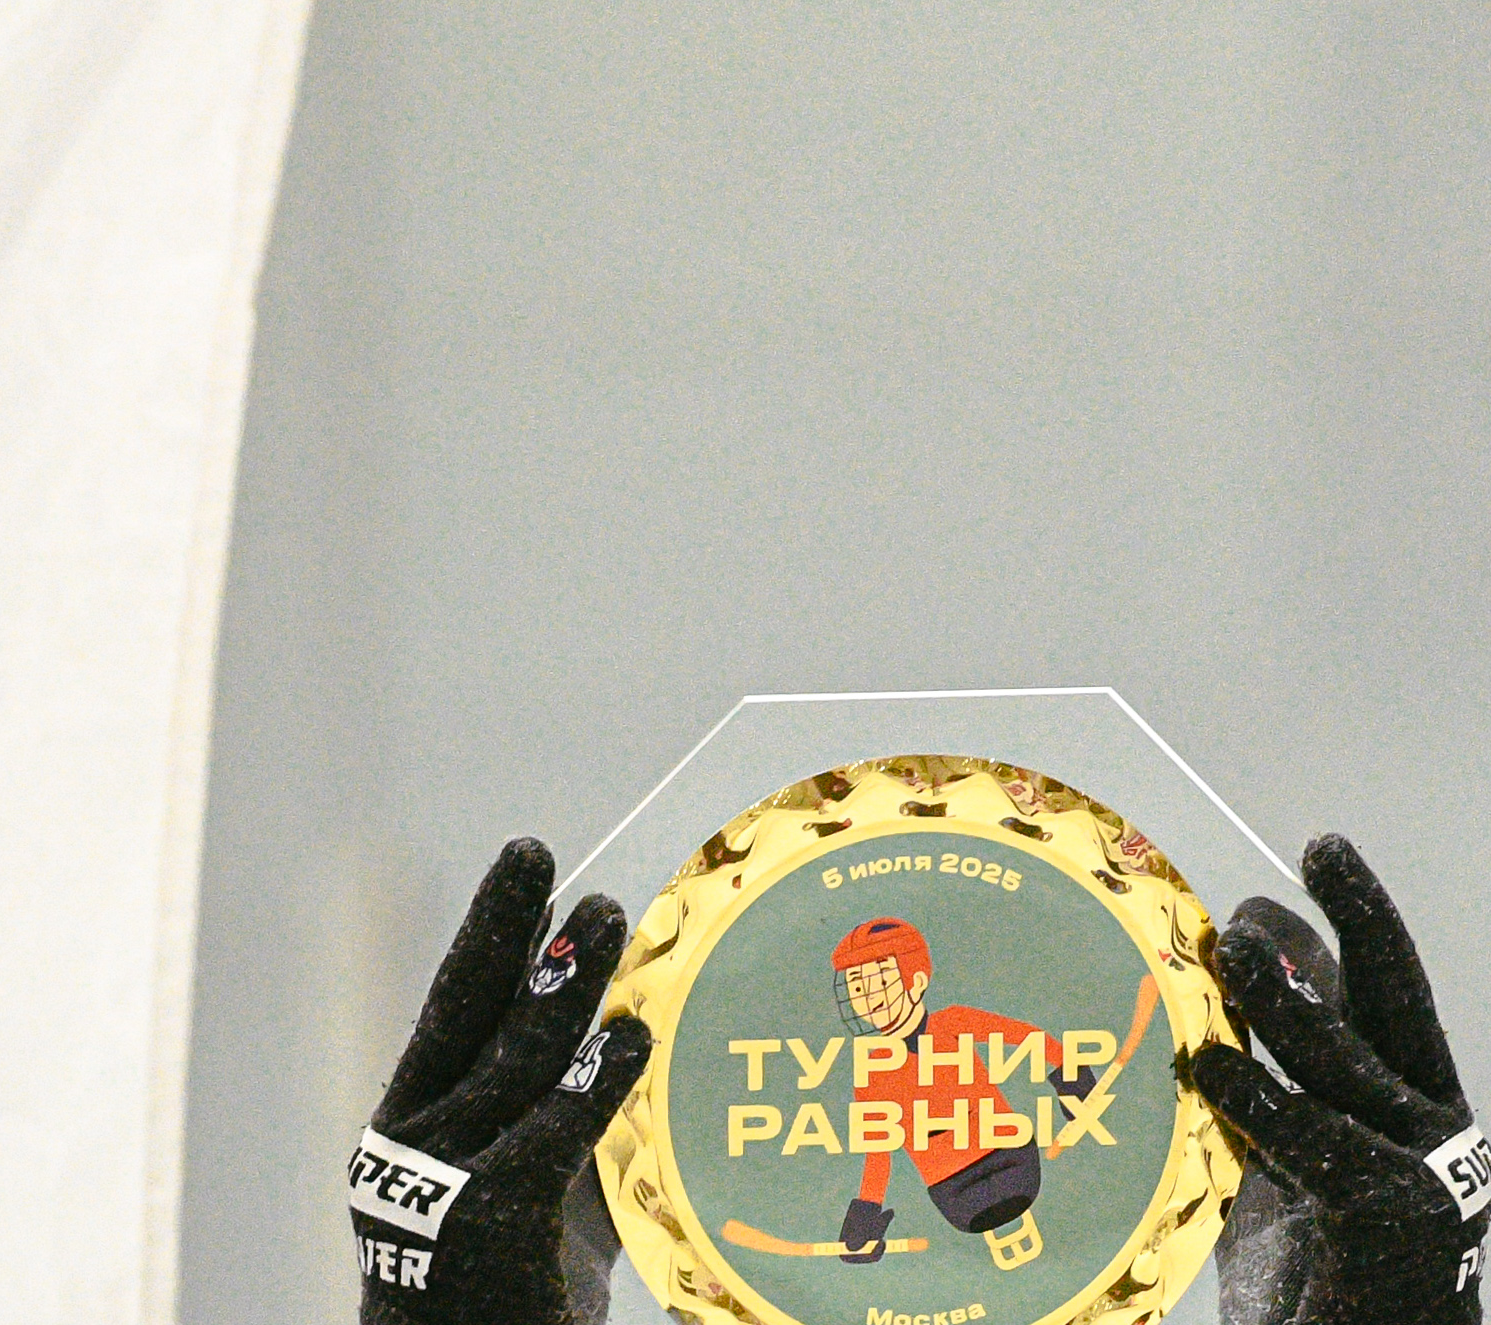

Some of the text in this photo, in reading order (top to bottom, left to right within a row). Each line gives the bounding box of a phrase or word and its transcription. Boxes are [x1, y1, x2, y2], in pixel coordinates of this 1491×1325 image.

[821, 853, 1024, 892] 5 июля 2025
[727, 1030, 1118, 1091] ТУРНИР
[727, 1094, 1118, 1157] РАВНЫХ
